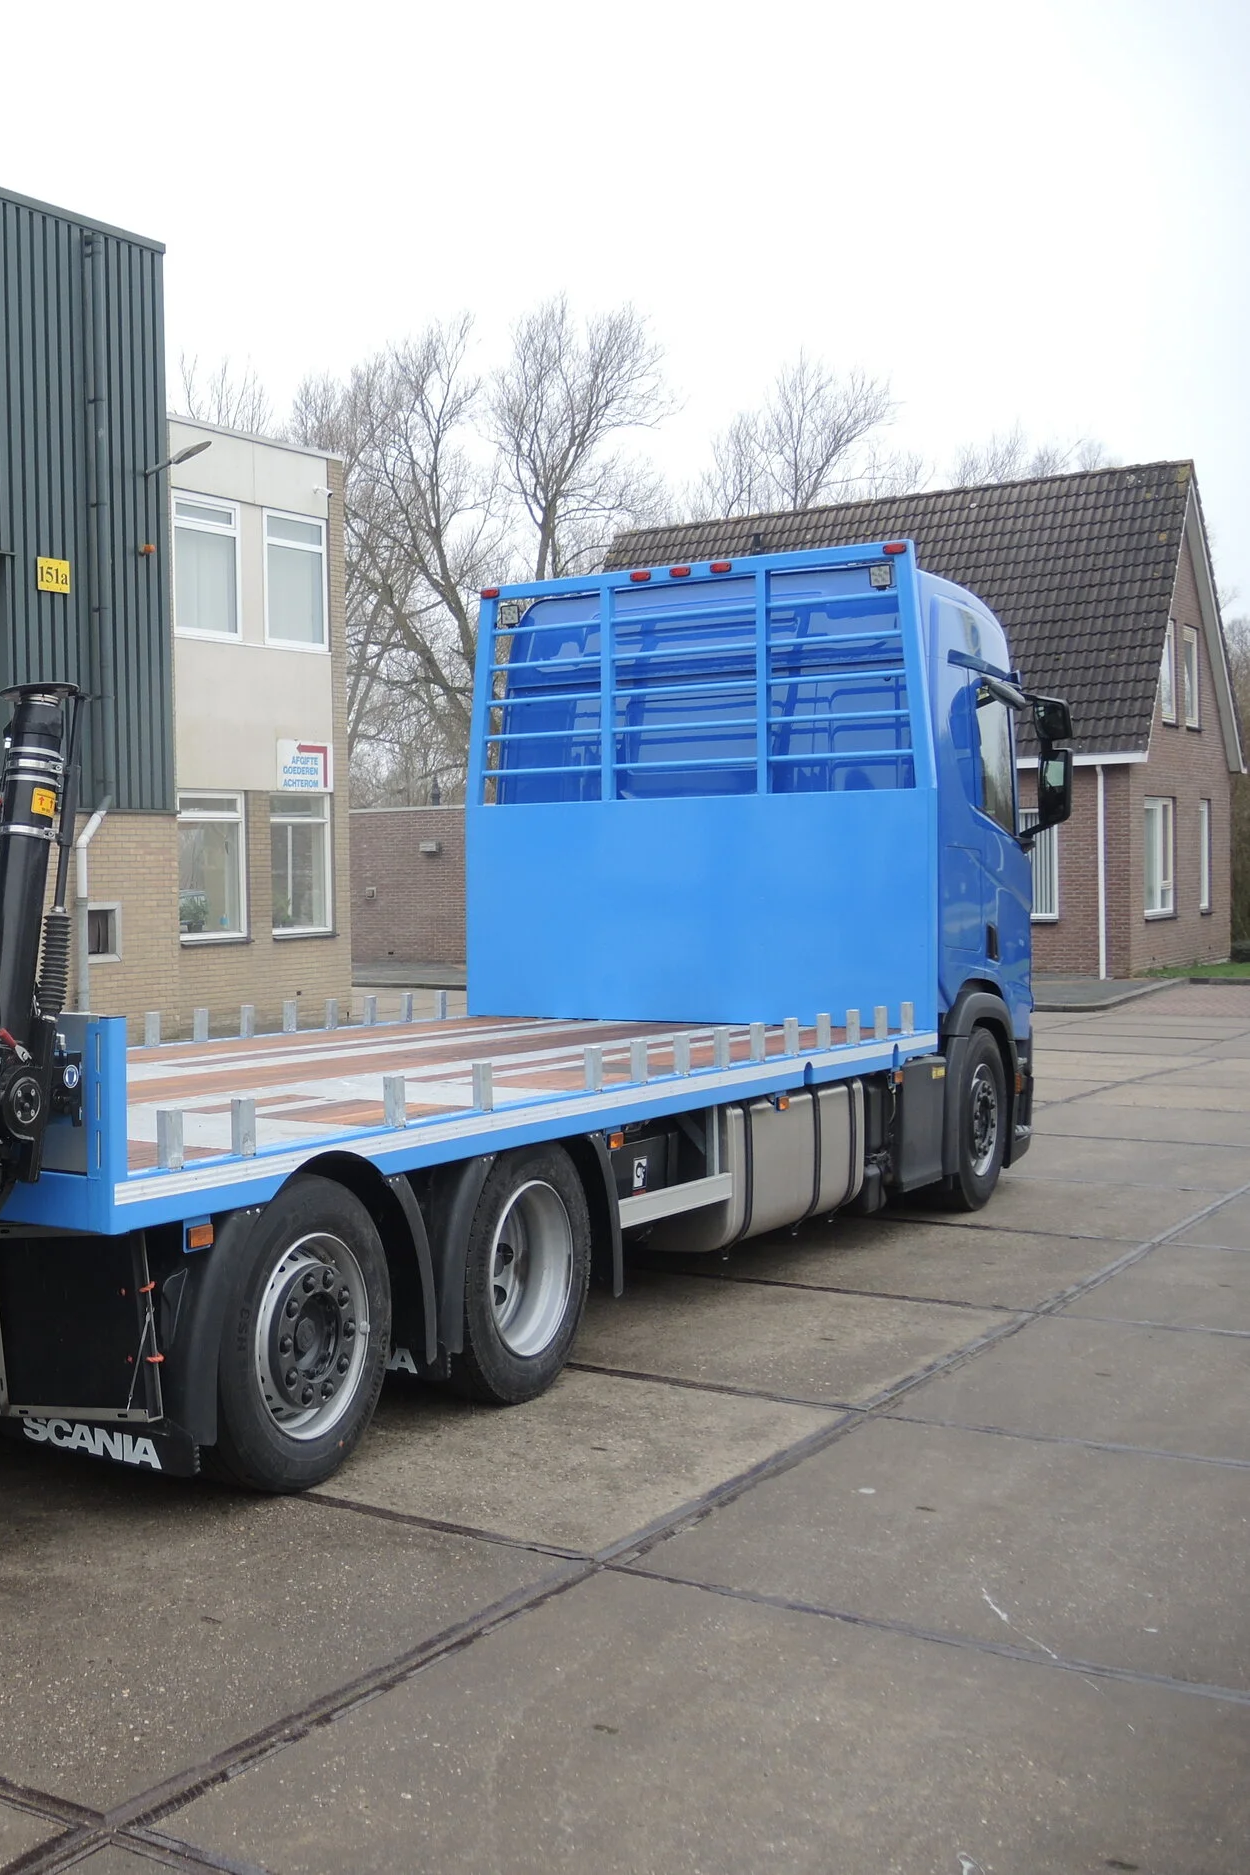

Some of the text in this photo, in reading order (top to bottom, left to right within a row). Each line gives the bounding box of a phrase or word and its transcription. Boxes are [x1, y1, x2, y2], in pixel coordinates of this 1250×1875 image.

[39, 565, 69, 586] 151a
[291, 755, 319, 766] AFGIFTE
[282, 766, 319, 776] GOEDEREN
[282, 779, 319, 788] ACHTEROM
[23, 1417, 163, 1470] SCANIA
